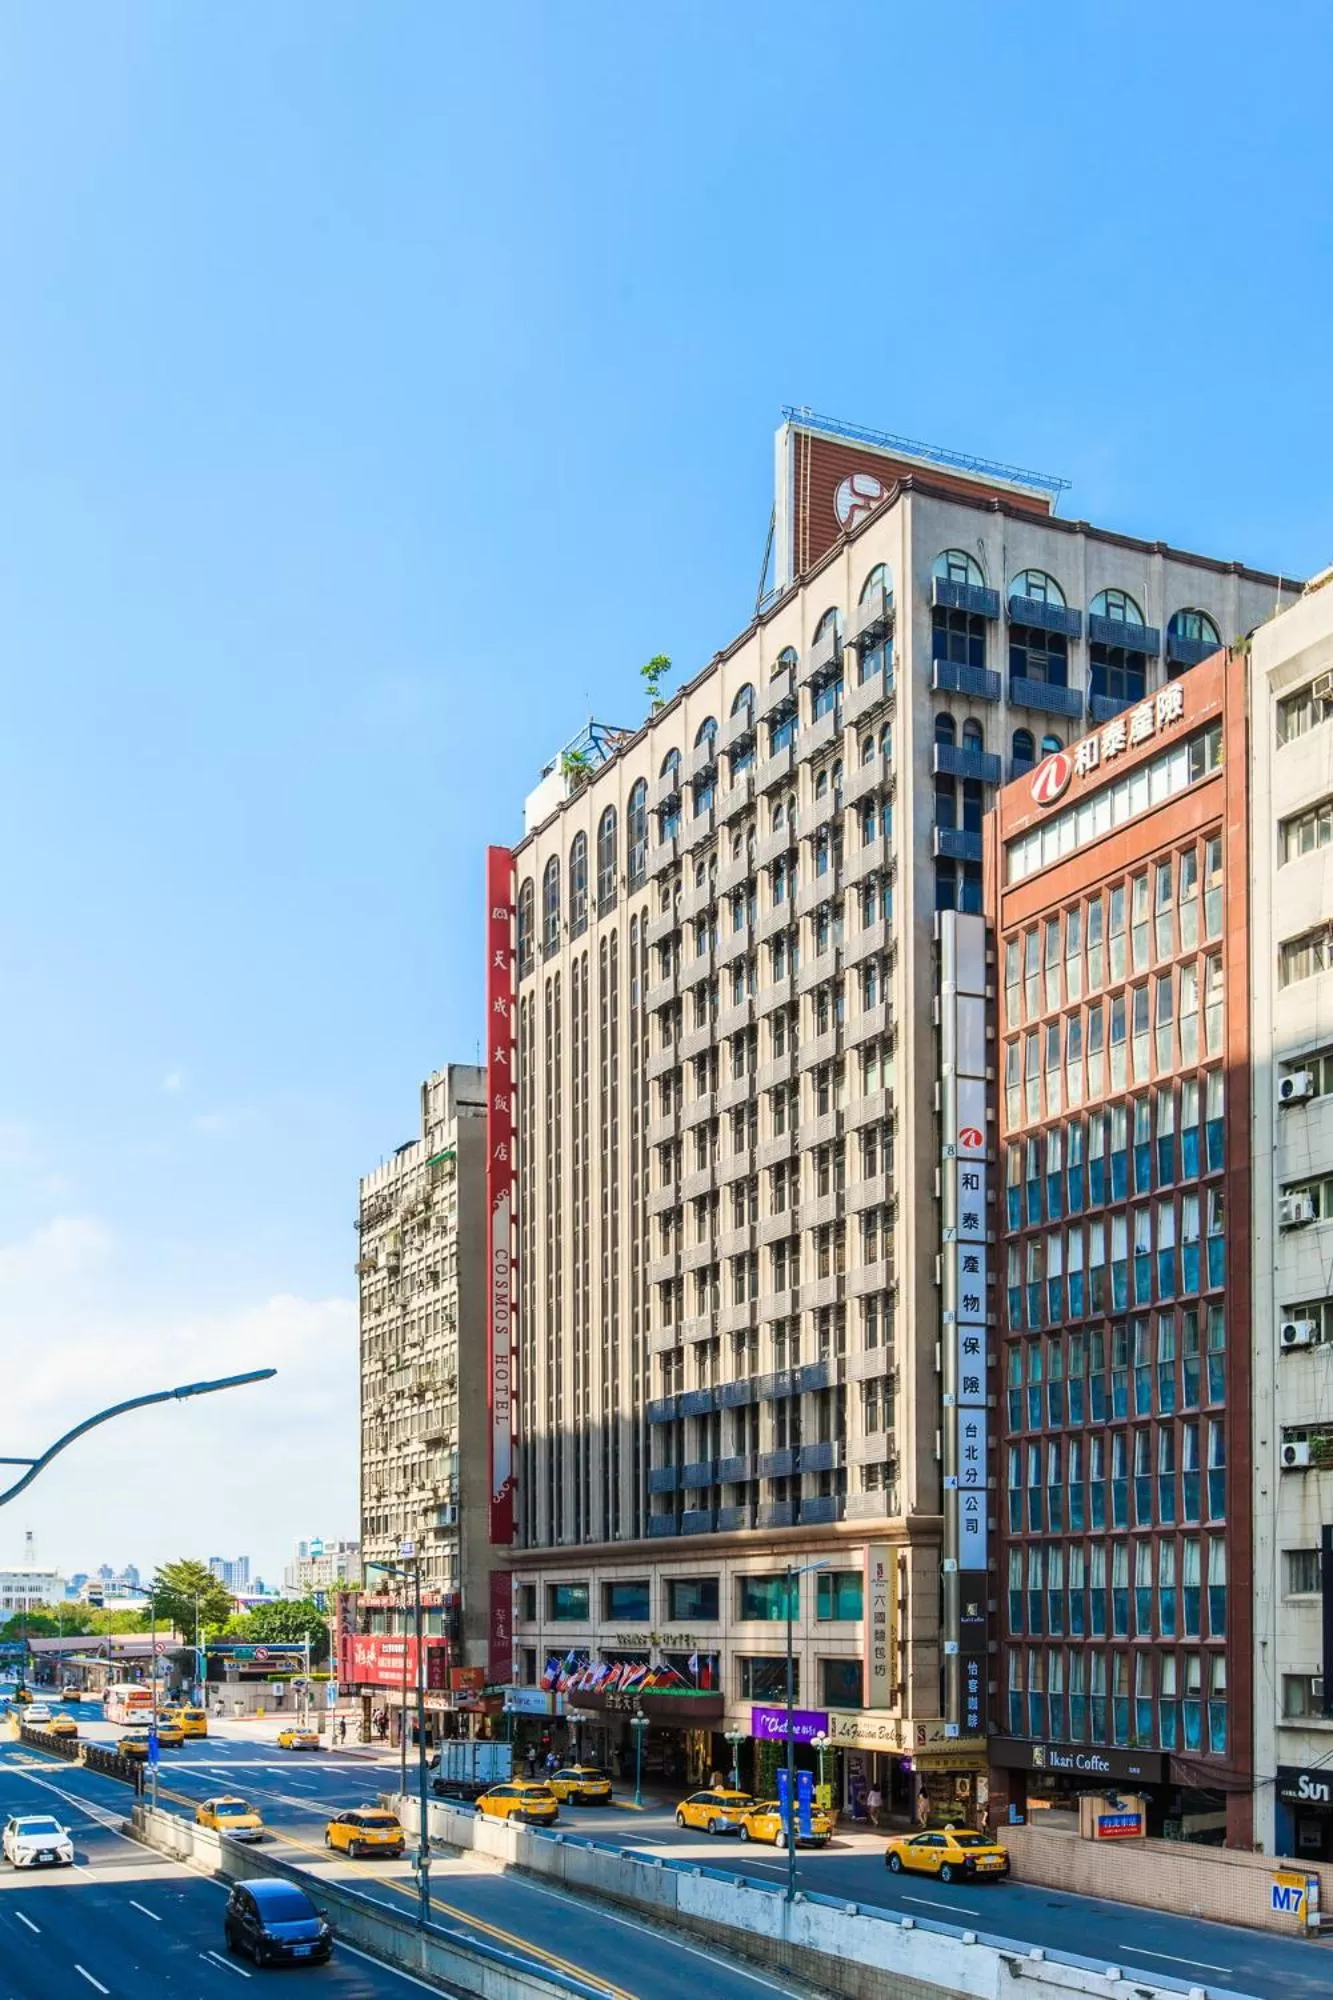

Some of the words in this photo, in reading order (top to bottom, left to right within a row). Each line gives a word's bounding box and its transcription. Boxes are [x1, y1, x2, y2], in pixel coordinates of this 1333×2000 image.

[1074, 682, 1184, 776] 和泰產險
[495, 1249, 508, 1334] COSMOS
[962, 1173, 980, 1393] 和泰產物保險
[495, 1354, 508, 1425] HOTEL
[965, 1424, 978, 1534] 台北分公司
[768, 1717, 801, 1735] Chatme
[1049, 1751, 1073, 1768] Ikari
[1076, 1754, 1110, 1771] Coffee
[1298, 1775, 1330, 1802] Sun
[1273, 1885, 1303, 1912] M7
